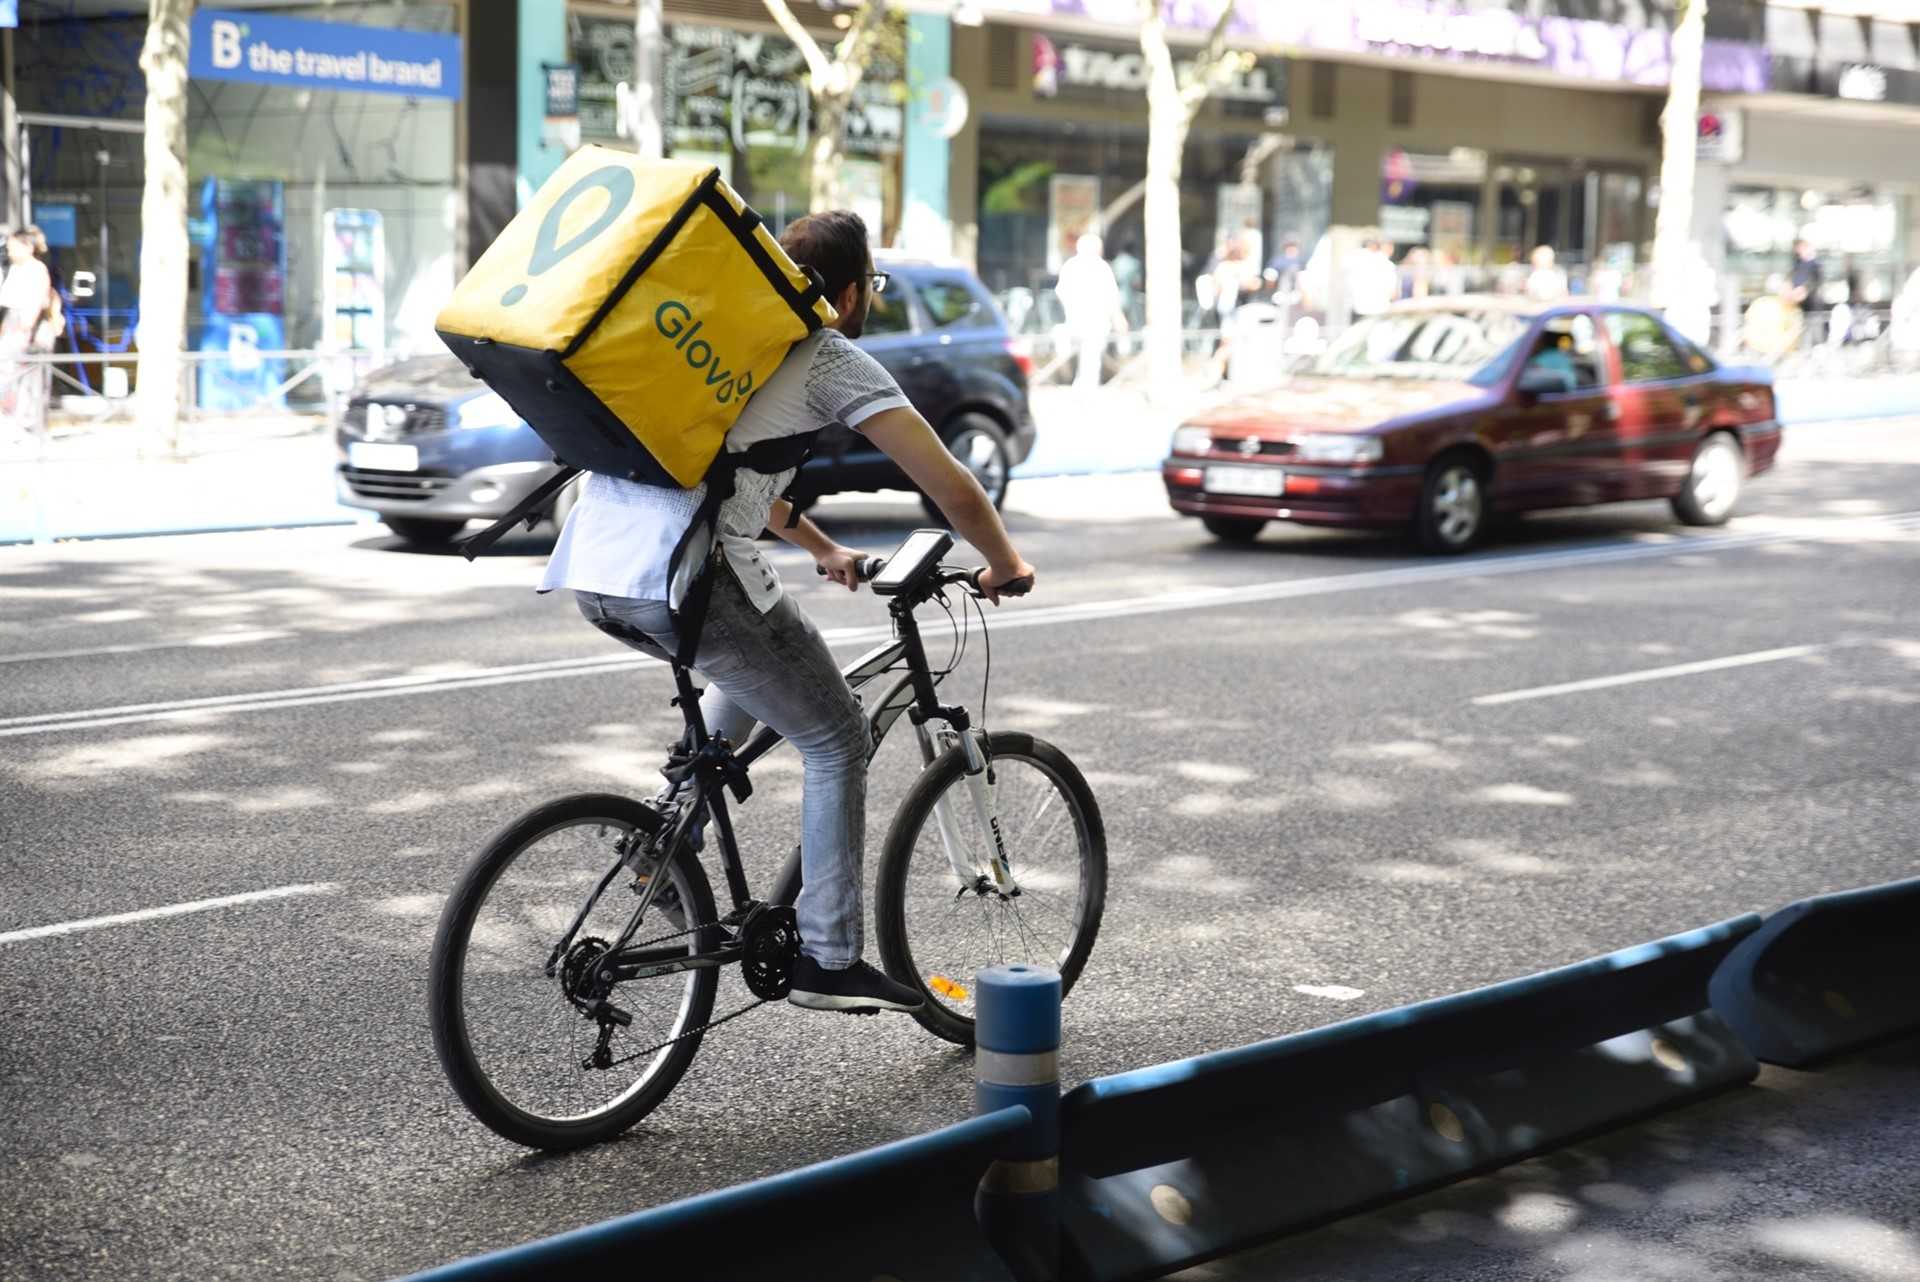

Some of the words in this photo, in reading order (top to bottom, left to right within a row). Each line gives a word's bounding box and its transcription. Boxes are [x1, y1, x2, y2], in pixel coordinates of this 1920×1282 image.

[248, 40, 293, 74] the
[296, 48, 366, 81] travel
[368, 52, 441, 88] brand
[655, 300, 752, 404] Glovo
